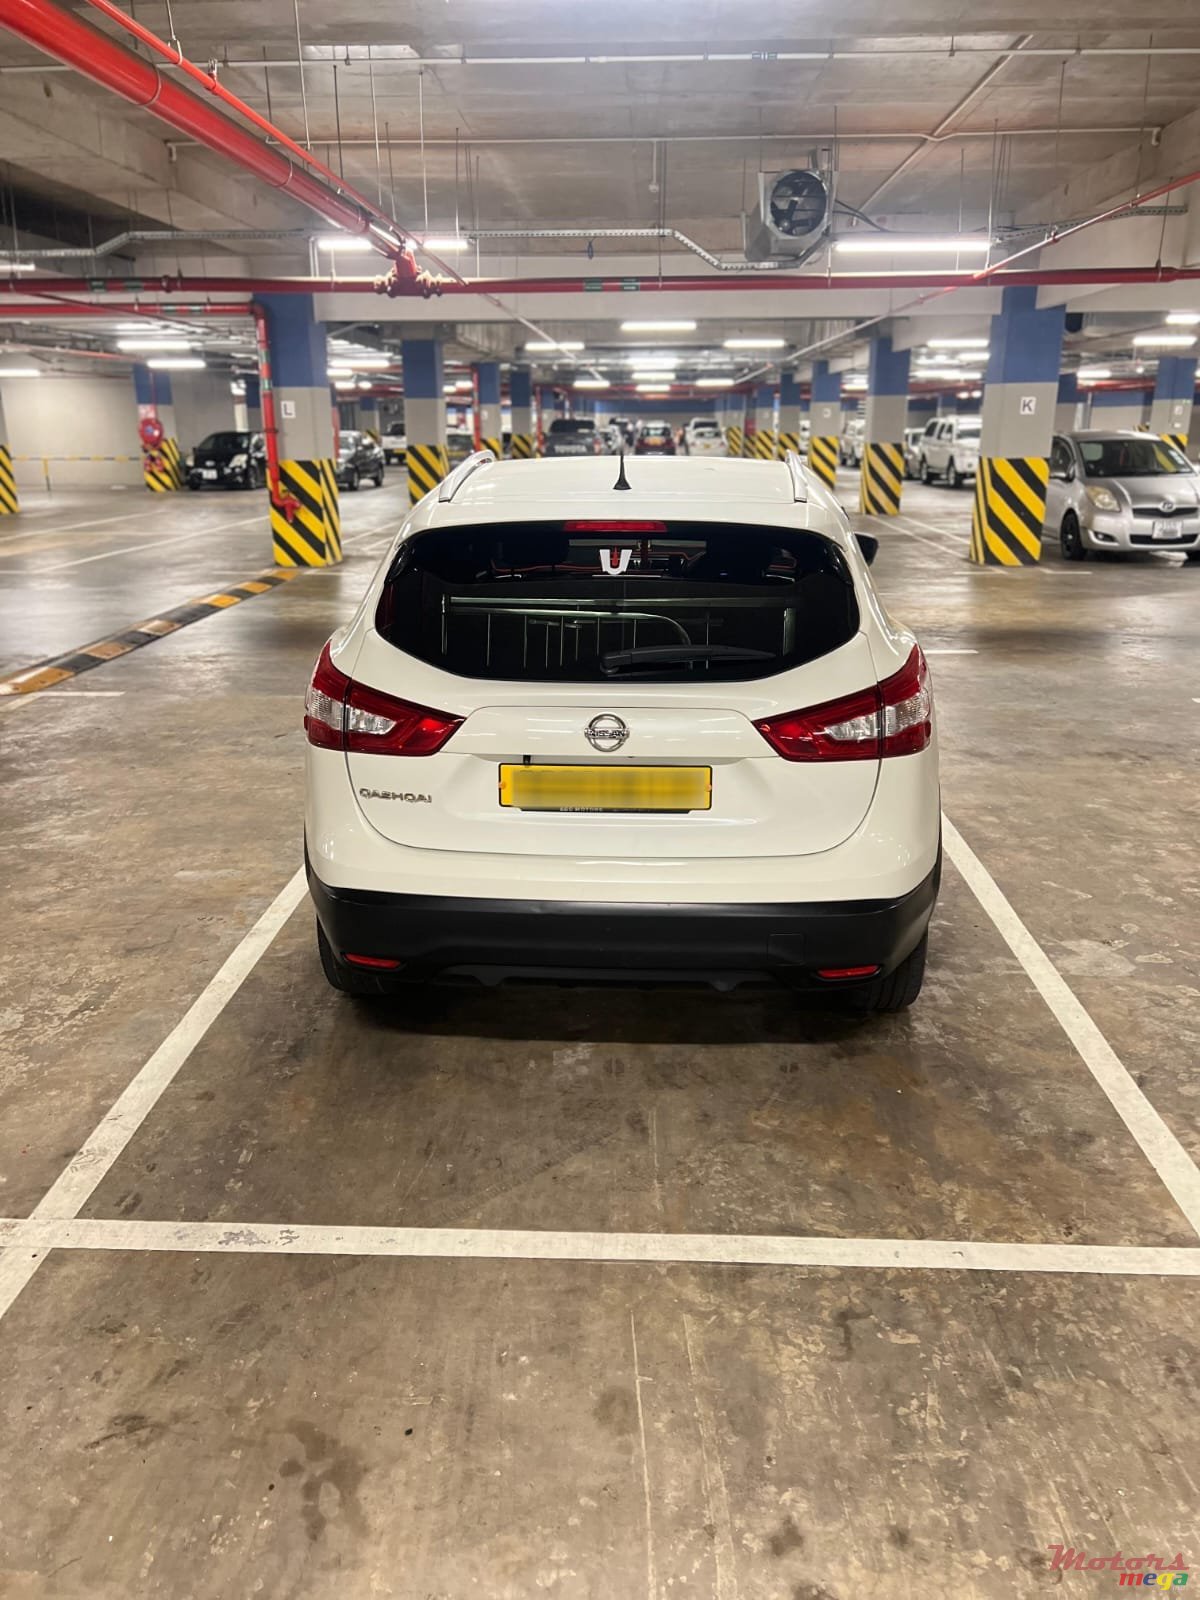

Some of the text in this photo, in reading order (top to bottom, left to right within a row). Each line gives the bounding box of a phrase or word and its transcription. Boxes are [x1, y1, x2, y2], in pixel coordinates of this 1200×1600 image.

[284, 403, 293, 416] L
[1022, 399, 1033, 412] K
[554, 444, 587, 454] TOYOTA
